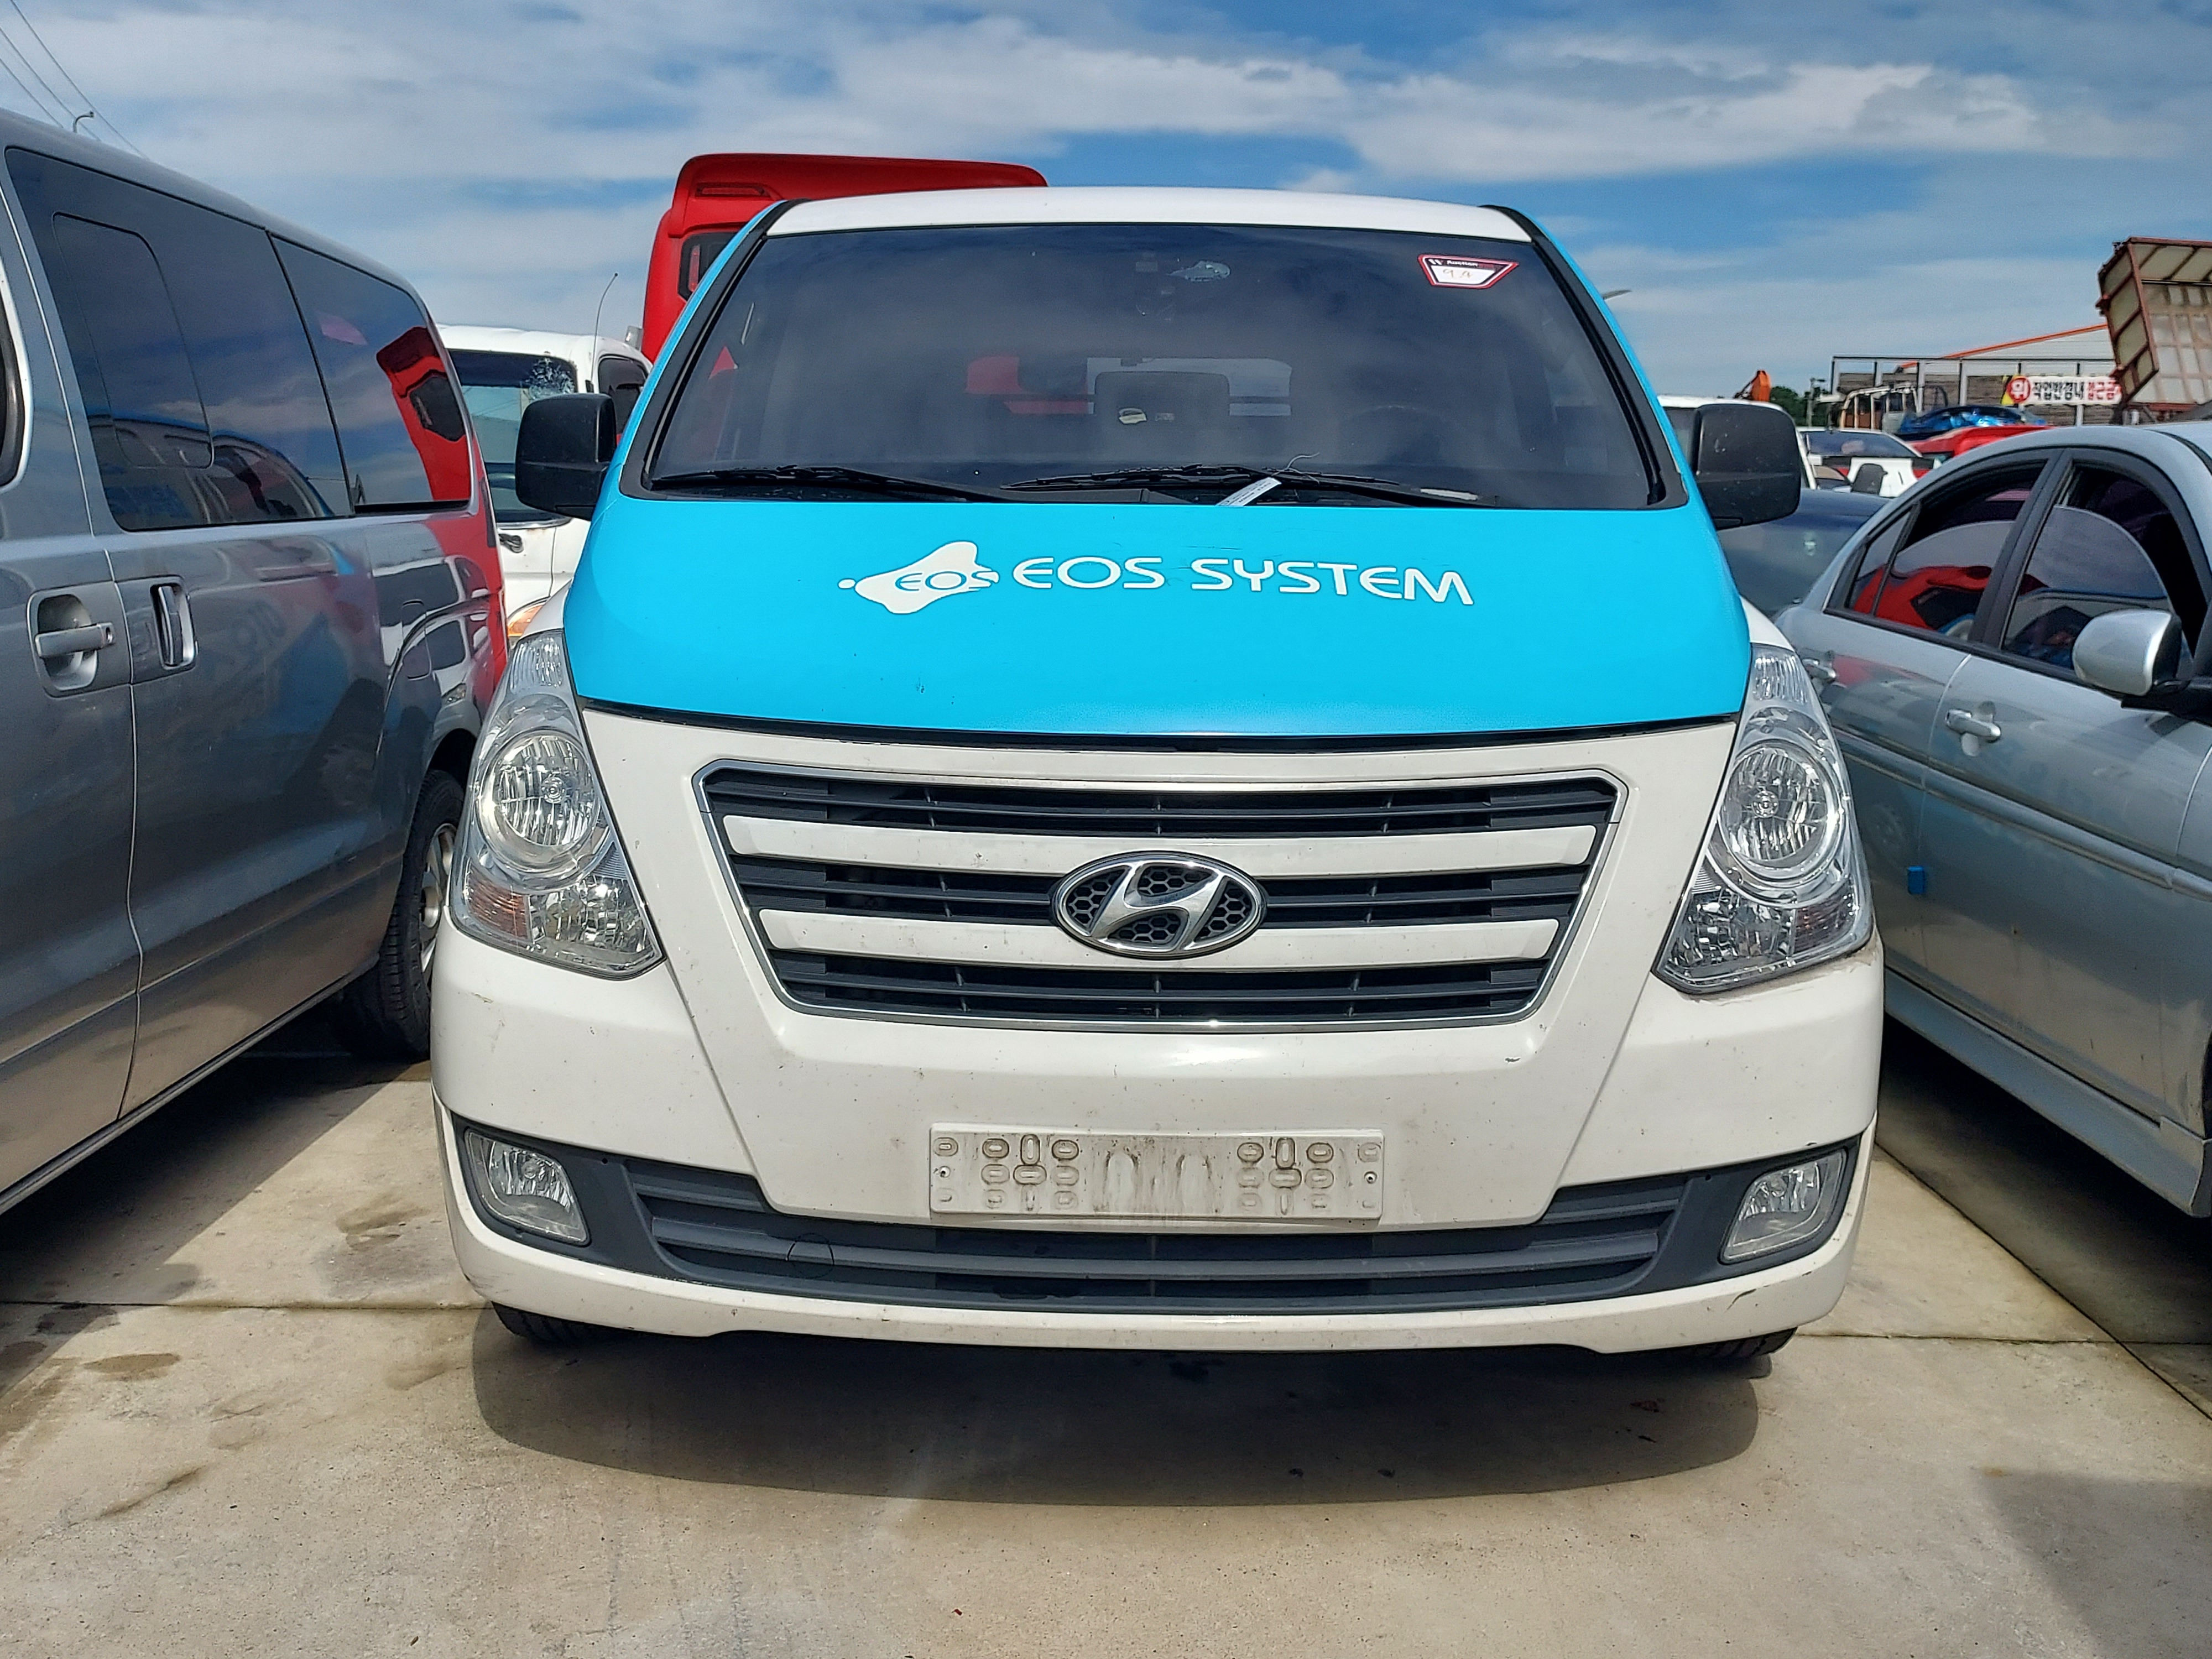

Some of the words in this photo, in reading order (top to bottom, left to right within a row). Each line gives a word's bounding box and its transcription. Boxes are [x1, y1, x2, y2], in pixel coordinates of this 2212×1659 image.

[2011, 380, 2028, 400] 위
[895, 571, 993, 591] EOS
[1013, 556, 1165, 588] EOS
[1191, 559, 1473, 605] SYSTEM
